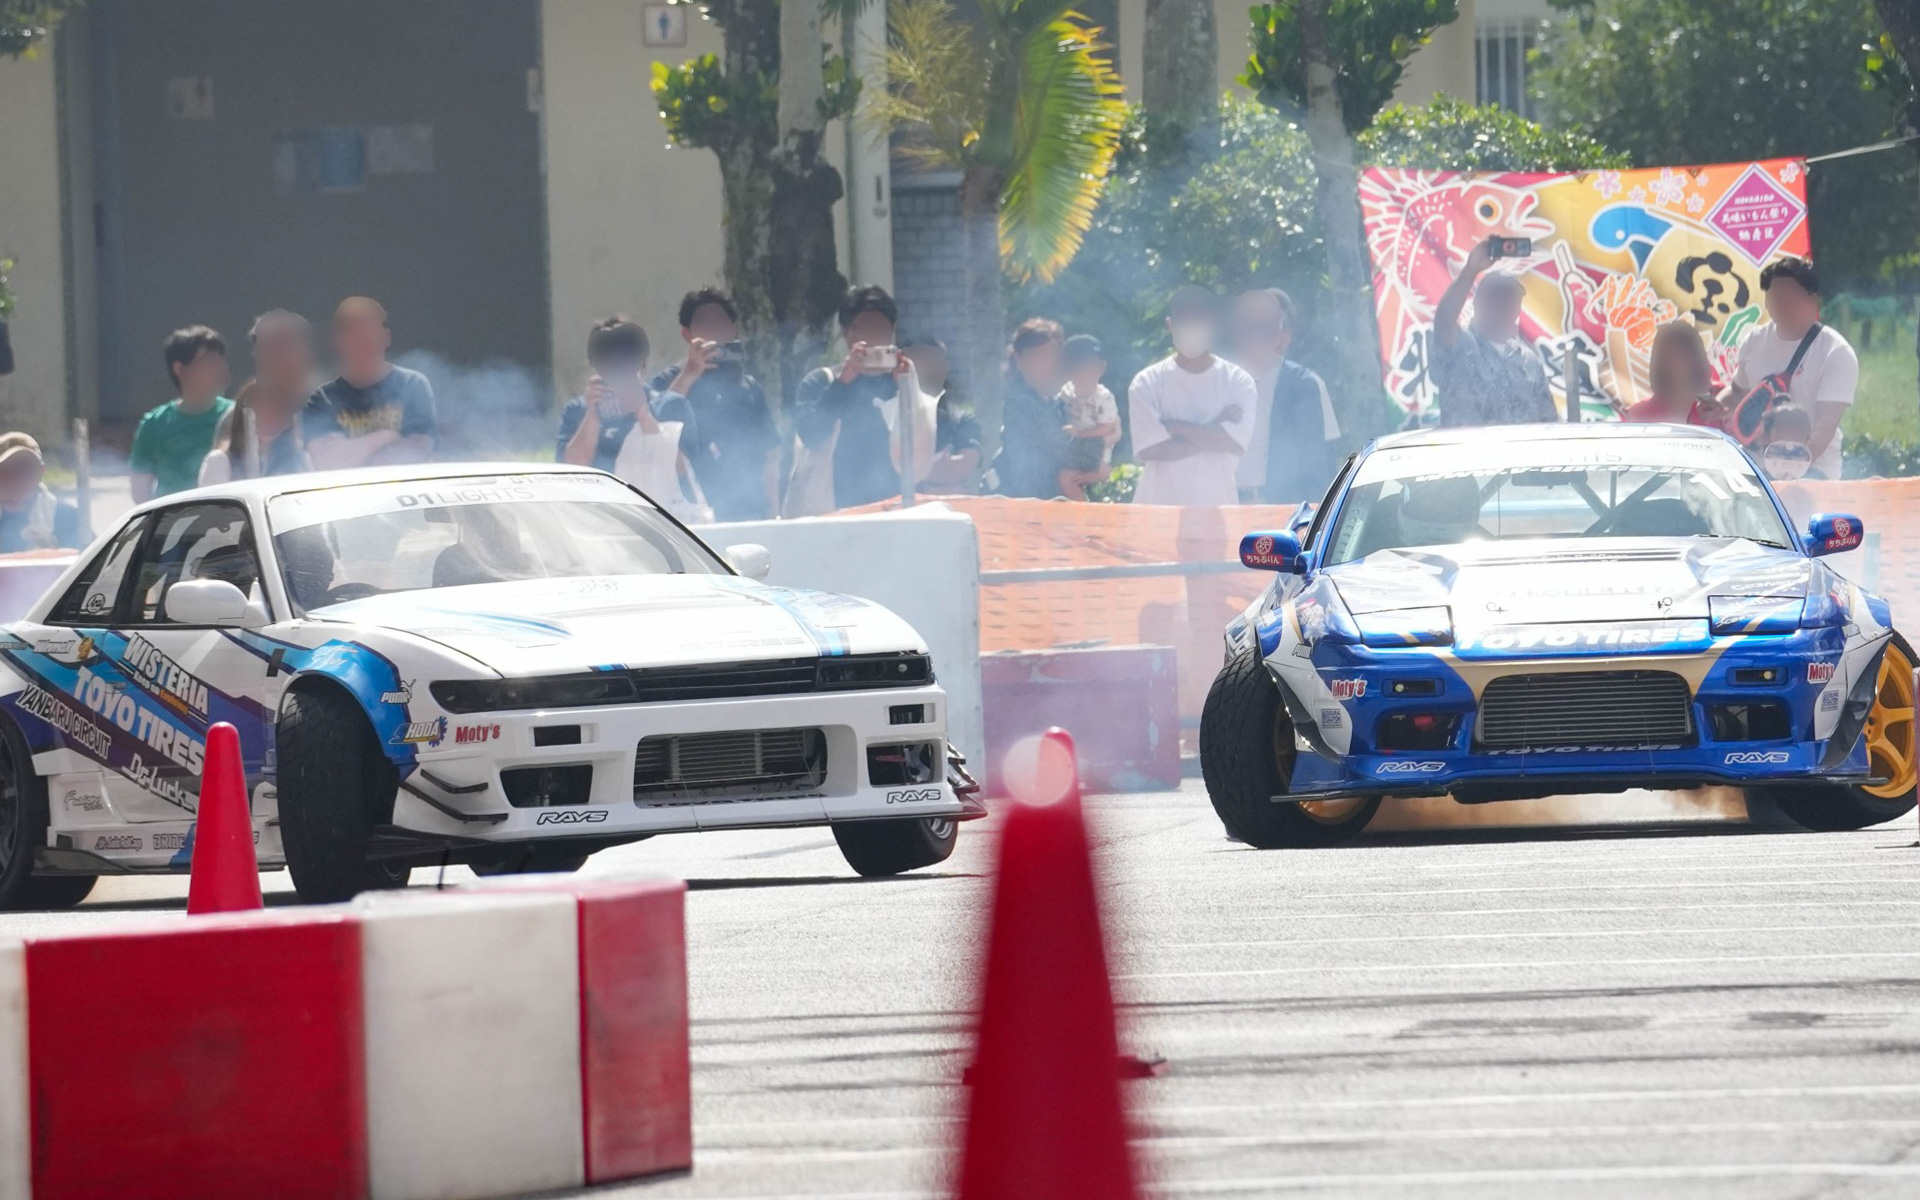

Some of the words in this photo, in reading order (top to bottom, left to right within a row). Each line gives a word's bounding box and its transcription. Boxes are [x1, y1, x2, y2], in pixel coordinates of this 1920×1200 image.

[396, 492, 435, 508] D1
[436, 486, 534, 505] LIGHTS
[1456, 630, 1575, 650] TOYO
[1581, 627, 1707, 645] TIRES
[122, 631, 209, 716] WISTERIA
[1808, 662, 1834, 682] Moty's
[1332, 680, 1366, 700] Moty's
[15, 682, 74, 734] YANBARU
[72, 713, 113, 760] CIRCUIT
[74, 665, 137, 732] TOYO
[137, 705, 206, 776] TIRES
[456, 724, 501, 743] Moty's
[1376, 761, 1446, 774] RAYS
[1724, 751, 1790, 765] RAYS
[887, 789, 941, 804] RAYS
[537, 810, 609, 825] RAYS
